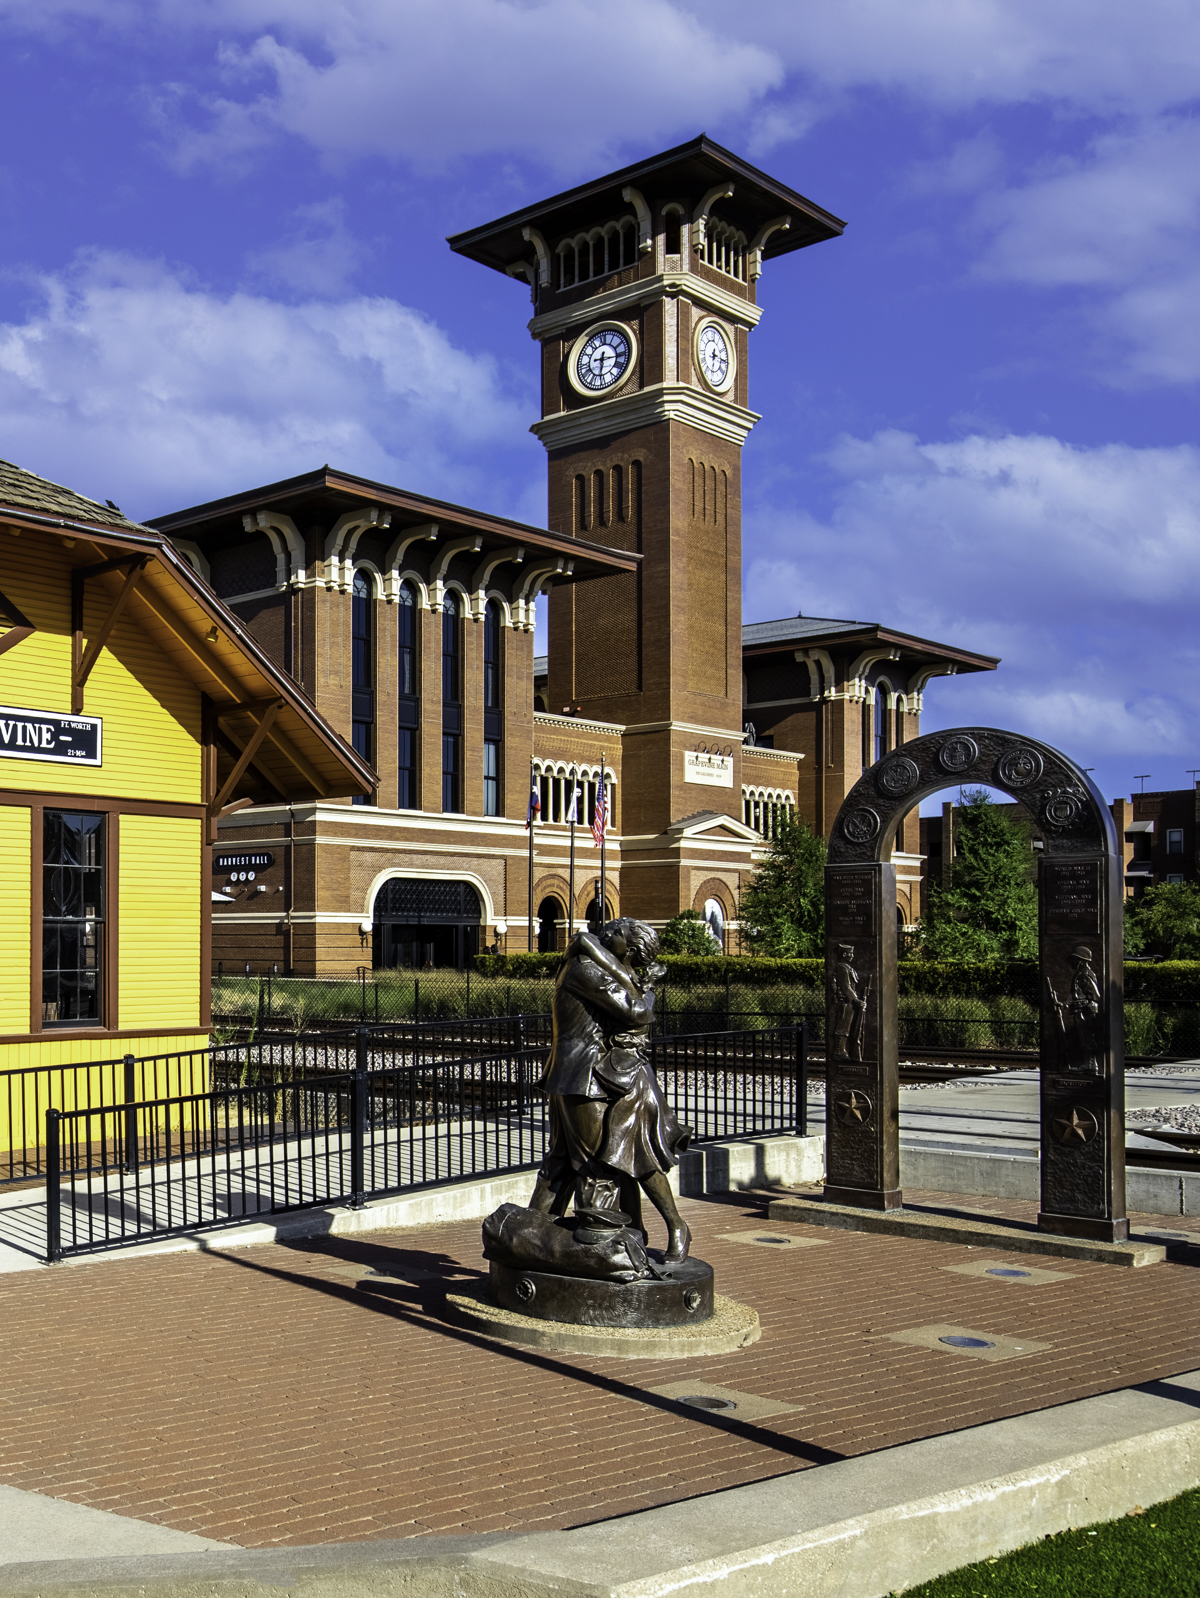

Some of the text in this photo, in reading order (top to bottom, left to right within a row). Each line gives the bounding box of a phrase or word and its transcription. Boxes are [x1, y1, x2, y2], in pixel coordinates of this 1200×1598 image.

[70, 722, 91, 731] WORTH
[220, 856, 268, 866] HARVEST HALL
